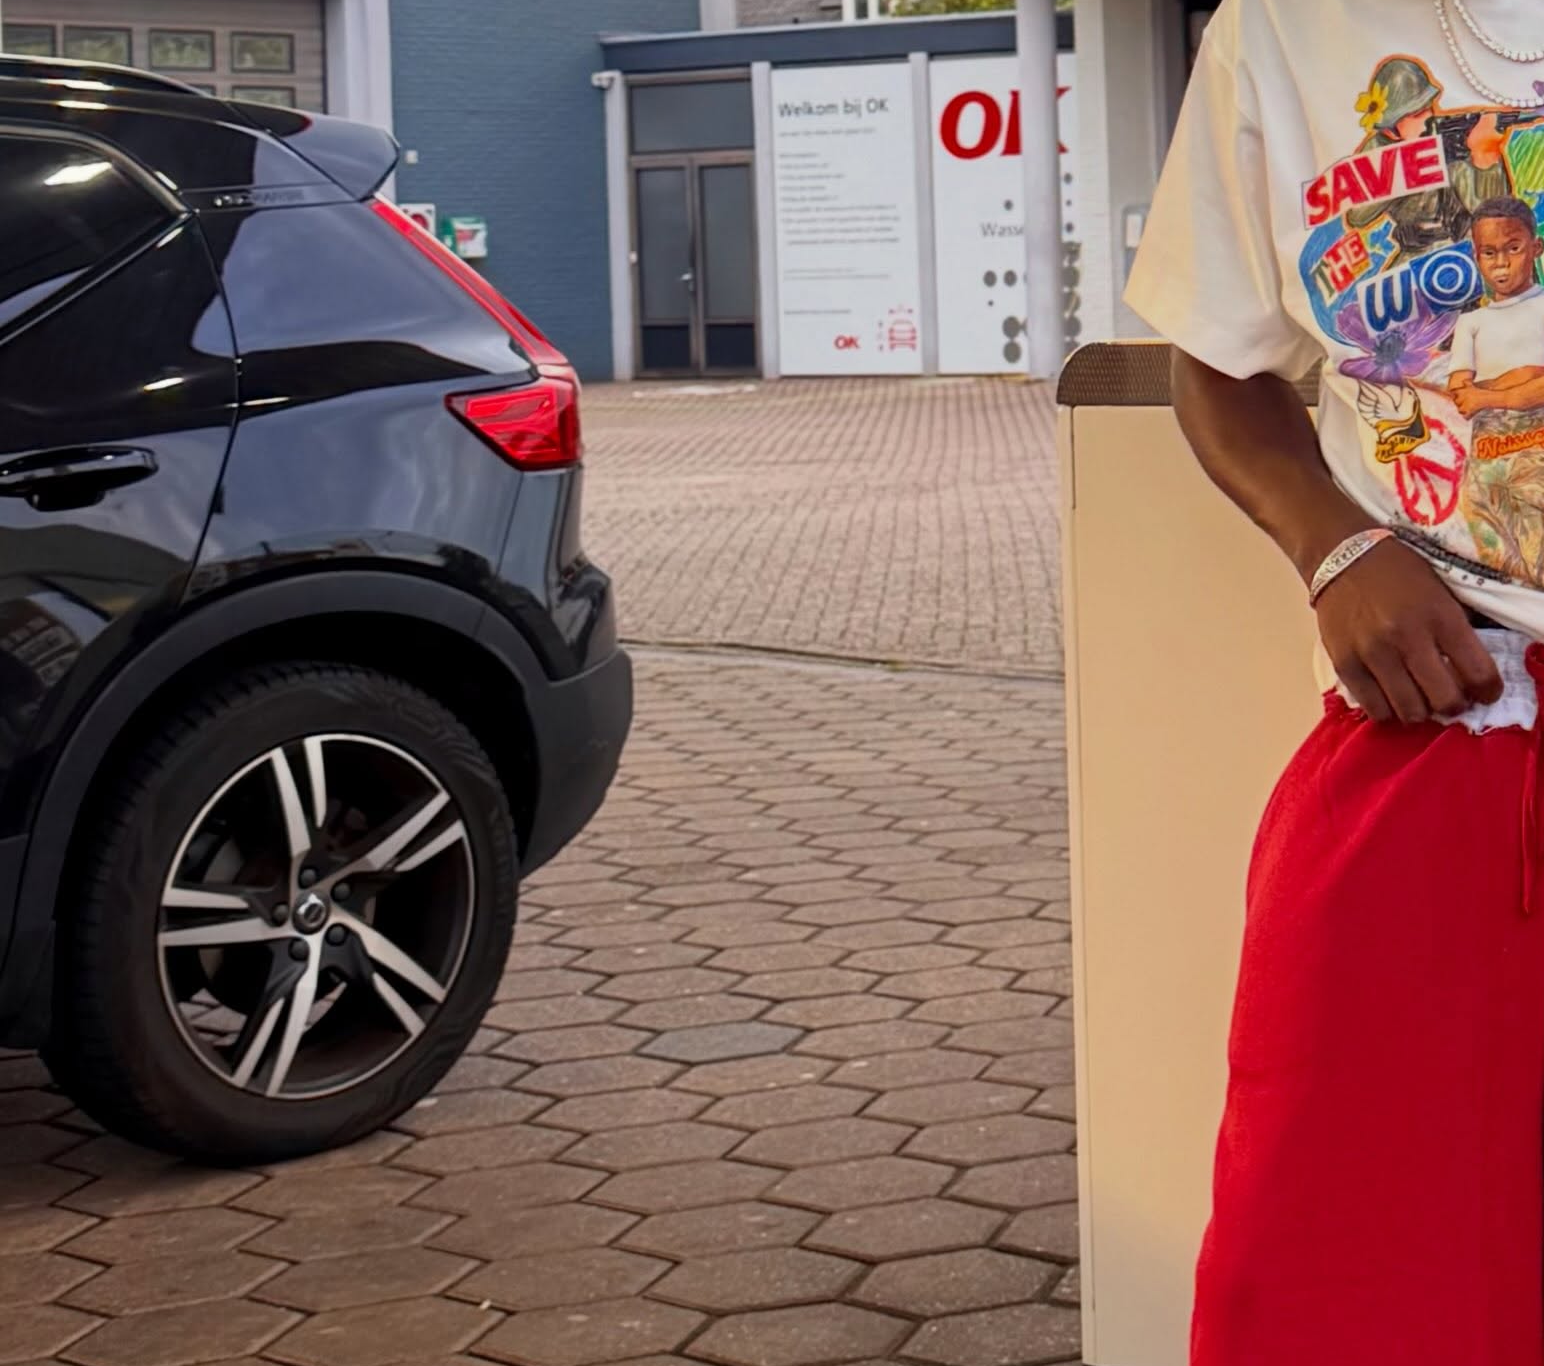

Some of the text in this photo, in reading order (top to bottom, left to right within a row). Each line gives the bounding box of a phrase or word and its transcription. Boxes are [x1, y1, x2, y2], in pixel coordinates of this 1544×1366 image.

[778, 97, 889, 119] Welkom bij OK
[1305, 137, 1446, 227] SAVE
[833, 335, 861, 350] OK
